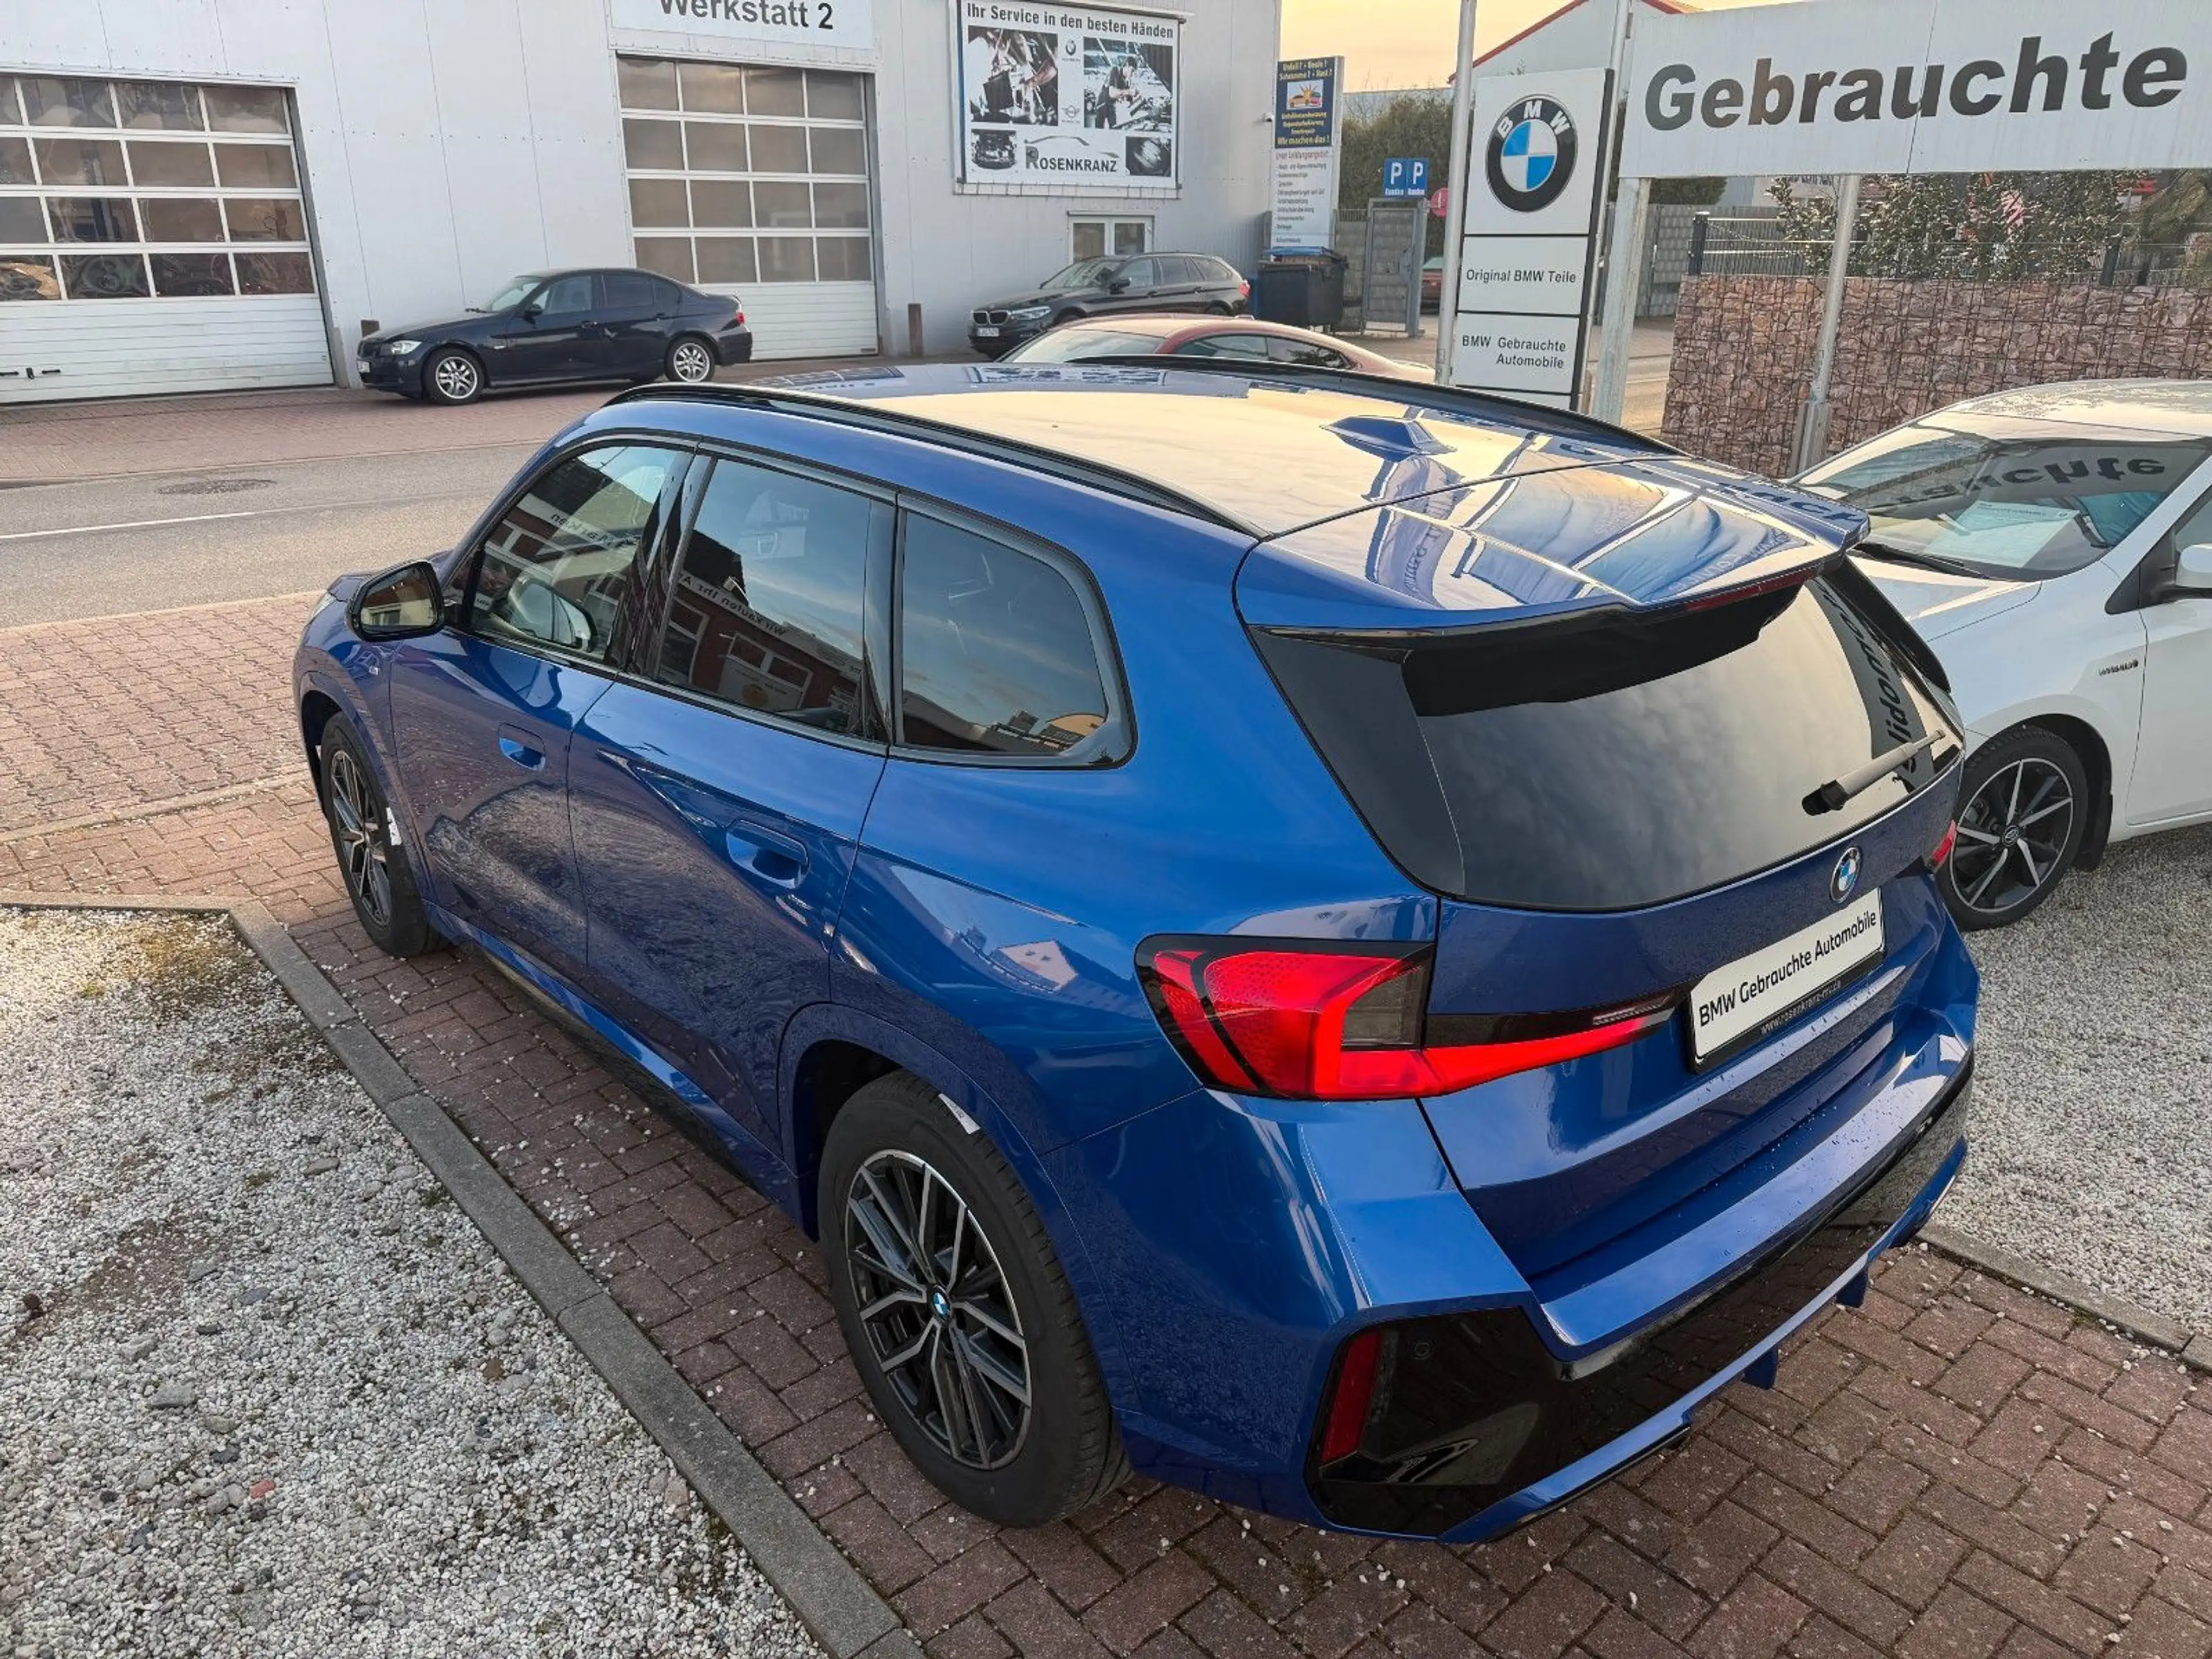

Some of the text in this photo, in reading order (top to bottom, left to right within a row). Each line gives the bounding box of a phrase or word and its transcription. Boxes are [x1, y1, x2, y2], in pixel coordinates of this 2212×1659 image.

[661, 0, 834, 29] Werkstatt 2
[967, 3, 1173, 38] Ihr Service in den besten Händen
[1645, 31, 2188, 131] Gebrauchte
[1498, 100, 1570, 139] BMW
[1025, 145, 1117, 172] ROSENKRANZ
[1391, 162, 1402, 185] P
[1412, 162, 1424, 185] P
[1467, 269, 1576, 283] Original BMW Teile
[1462, 335, 1566, 352] BMW Gebrauchte
[1496, 353, 1565, 369] Automobile
[1699, 911, 1877, 1027] BMW Gebrauchte Automobile
